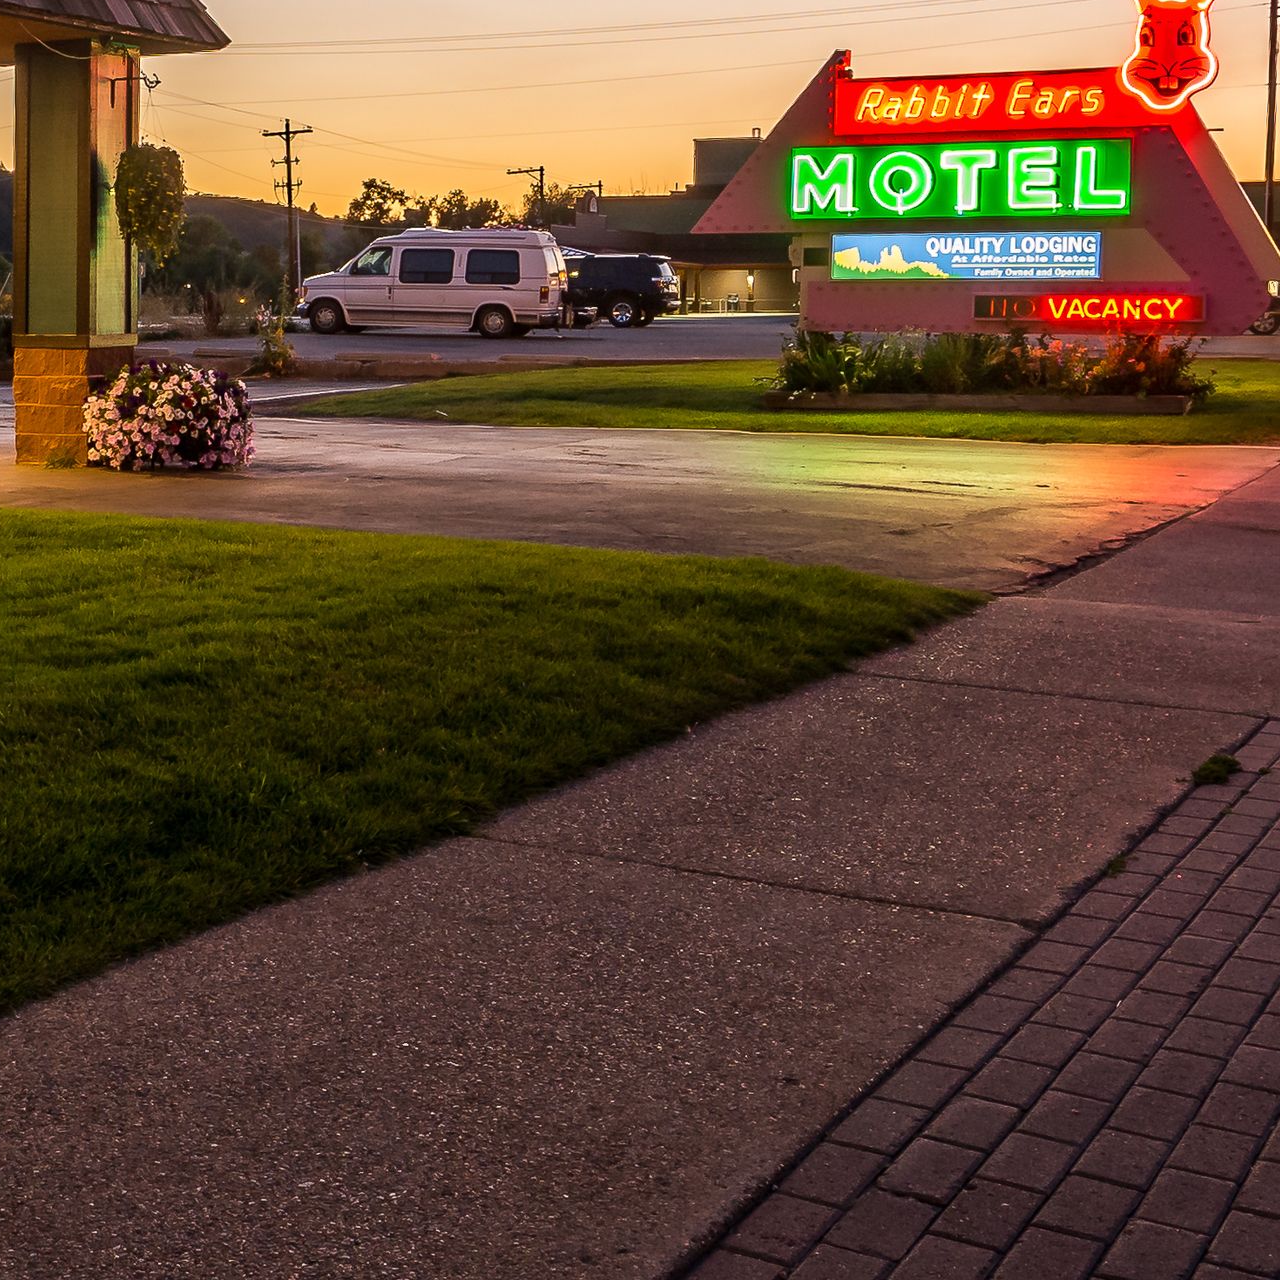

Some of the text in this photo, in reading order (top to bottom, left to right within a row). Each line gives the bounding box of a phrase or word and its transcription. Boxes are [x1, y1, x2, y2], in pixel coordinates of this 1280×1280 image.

[857, 81, 1104, 121] Rabbit Ears
[793, 147, 1126, 214] MOTEL
[926, 236, 1097, 257] QUALITY LODGING
[951, 255, 1096, 263] At Affordable Rates
[974, 268, 1096, 278] Family Owned and Operated
[1048, 298, 1184, 320] VACANCY
